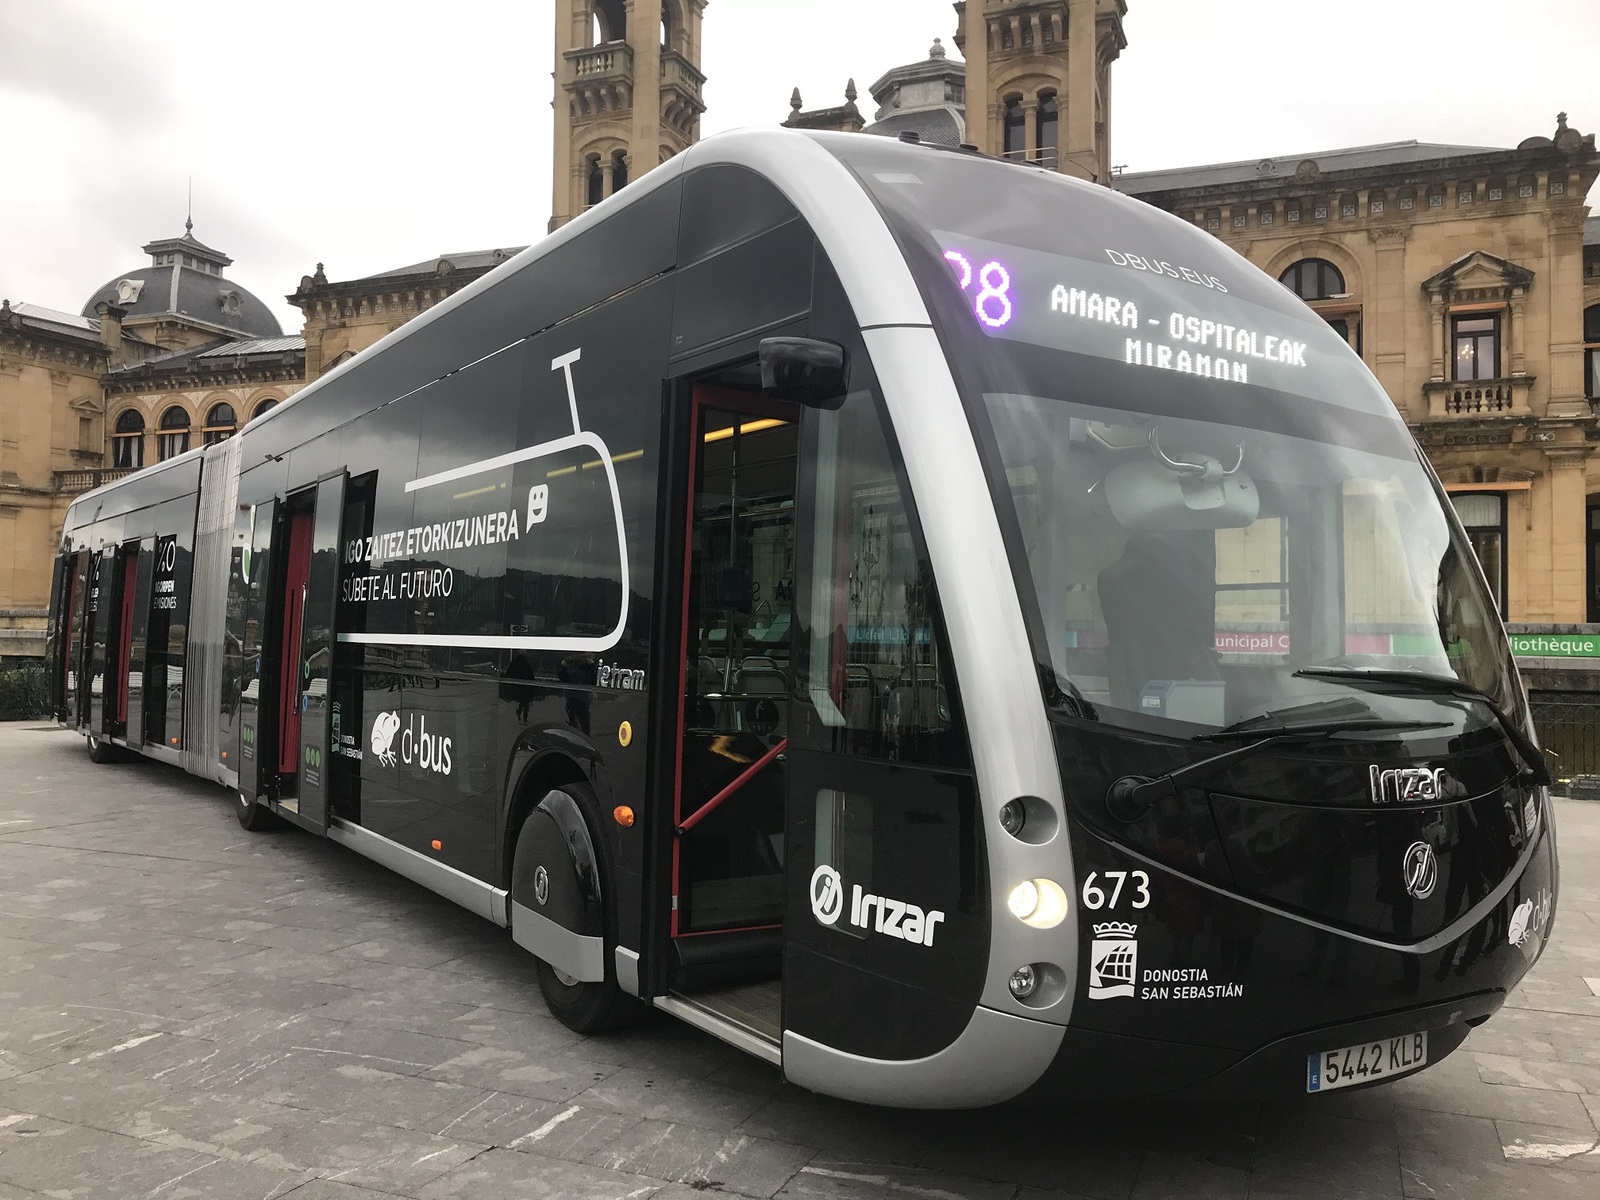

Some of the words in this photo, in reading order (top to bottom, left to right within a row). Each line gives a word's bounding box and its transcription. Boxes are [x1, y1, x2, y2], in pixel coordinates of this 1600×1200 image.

[1104, 247, 1229, 294] DBUS.EUS
[1049, 283, 1139, 329] AMARA
[1168, 311, 1308, 368] OSPITALEAK
[1124, 337, 1249, 384] MIRAMON
[344, 538, 363, 564] IGO
[364, 530, 405, 562] ZAITEZ
[406, 508, 519, 556] ETORKIZUNERA
[341, 571, 381, 602] SÚBETE
[382, 573, 396, 600] AL
[399, 567, 453, 599] FUTURO
[1369, 763, 1446, 803] Irizar
[1082, 870, 1151, 910] 673
[850, 884, 945, 947] Irizar
[1140, 987, 1170, 1001] SAN
[1172, 981, 1244, 1000] SEBASTIÁN
[1142, 968, 1209, 983] DONOSTIA
[1325, 1043, 1383, 1084] 5442
[1389, 1033, 1424, 1070] KLB
